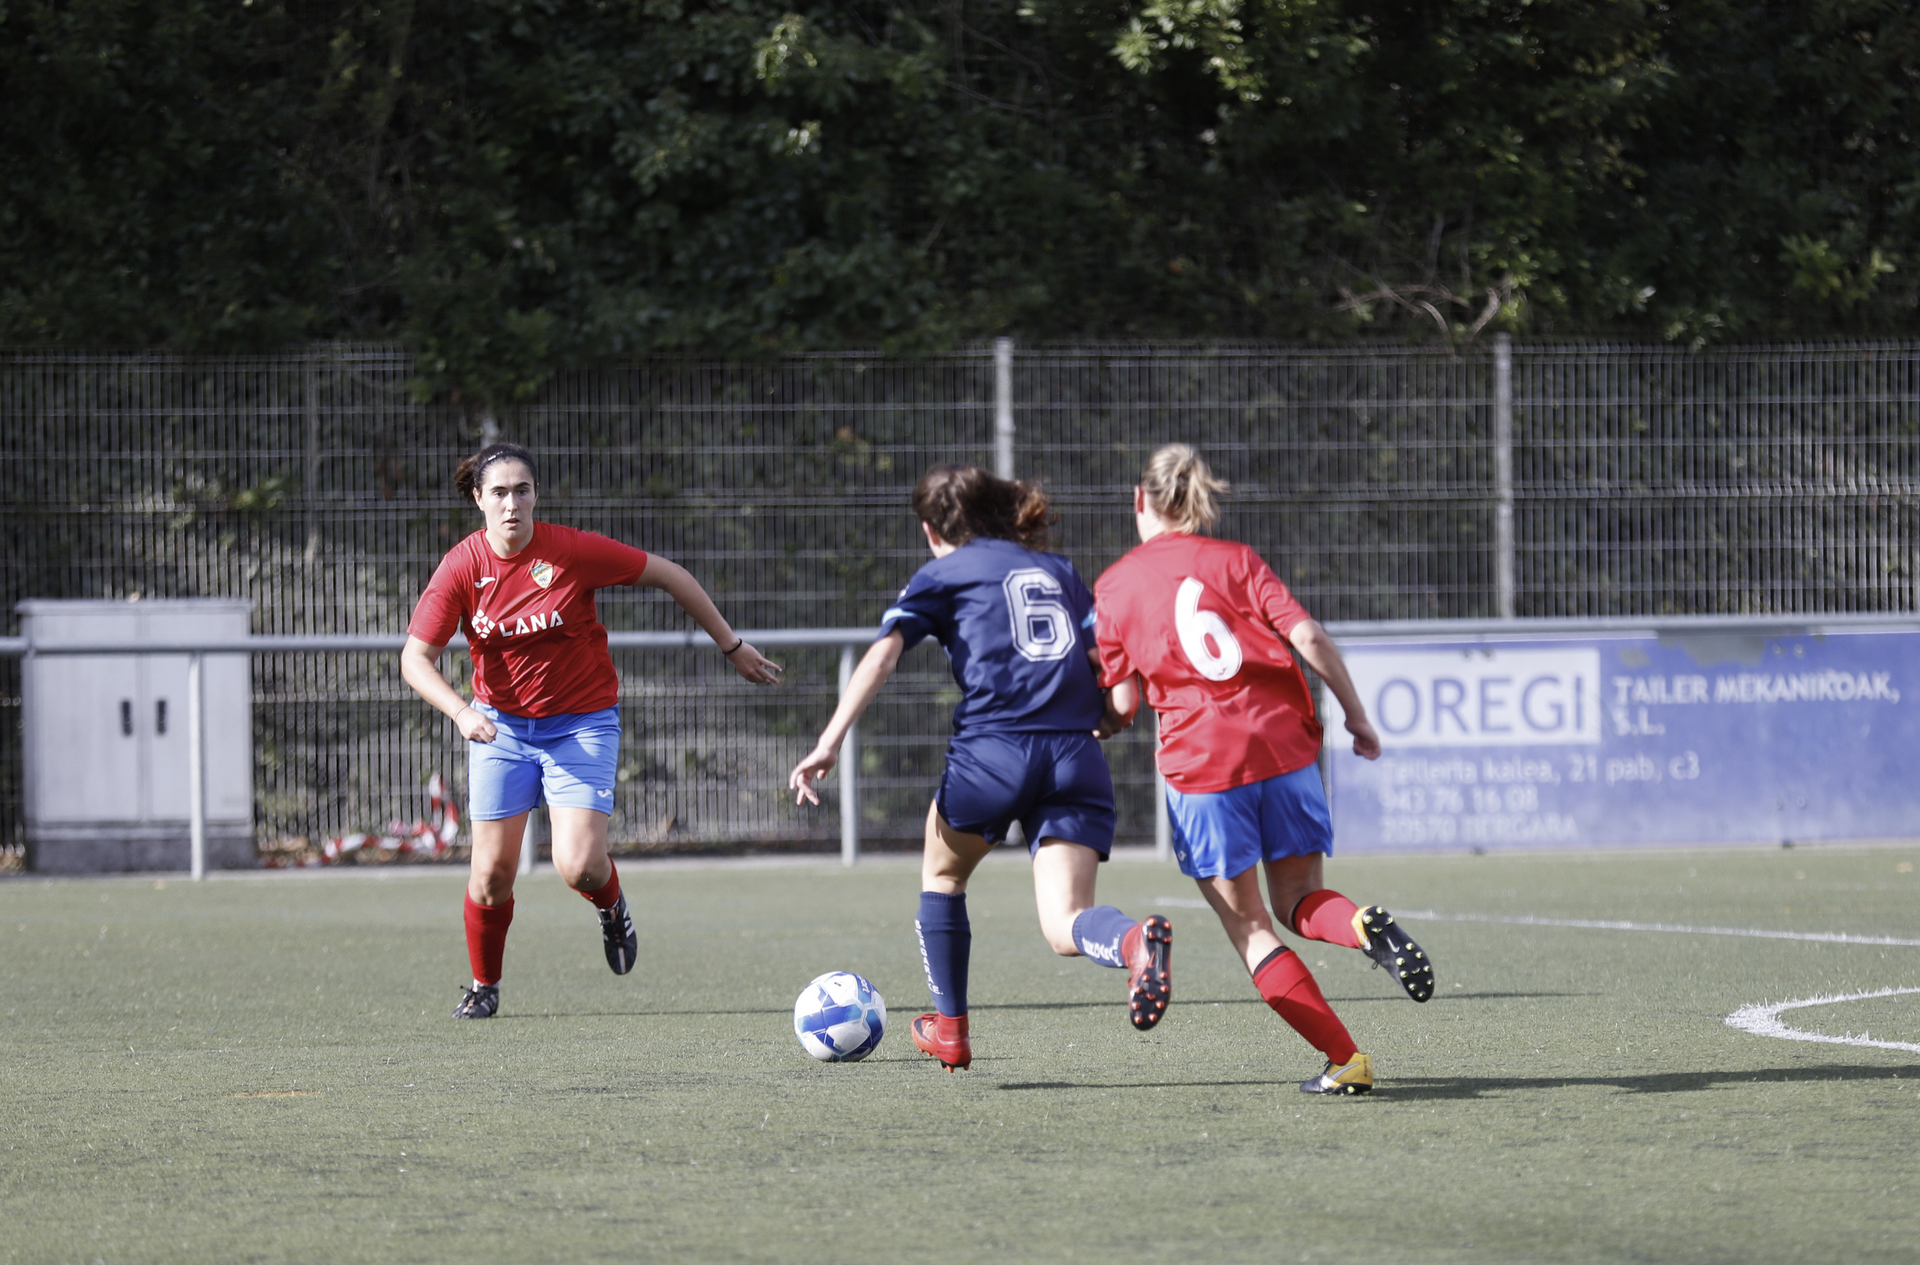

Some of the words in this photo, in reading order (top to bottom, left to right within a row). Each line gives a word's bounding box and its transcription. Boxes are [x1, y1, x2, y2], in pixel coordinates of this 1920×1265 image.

[498, 609, 565, 638] LANA
[1002, 567, 1076, 663] 6
[1174, 577, 1243, 682] 6
[1376, 675, 1584, 735] OREGI
[1612, 674, 1709, 704] TAILER
[1611, 704, 1666, 736] S.L.
[1483, 755, 1561, 786] kalea,
[1568, 753, 1597, 782] 21
[1668, 750, 1700, 780] c3
[1379, 786, 1426, 814] 943
[1432, 786, 1464, 814] 76
[1471, 785, 1501, 813] 16
[1504, 784, 1539, 812] 08
